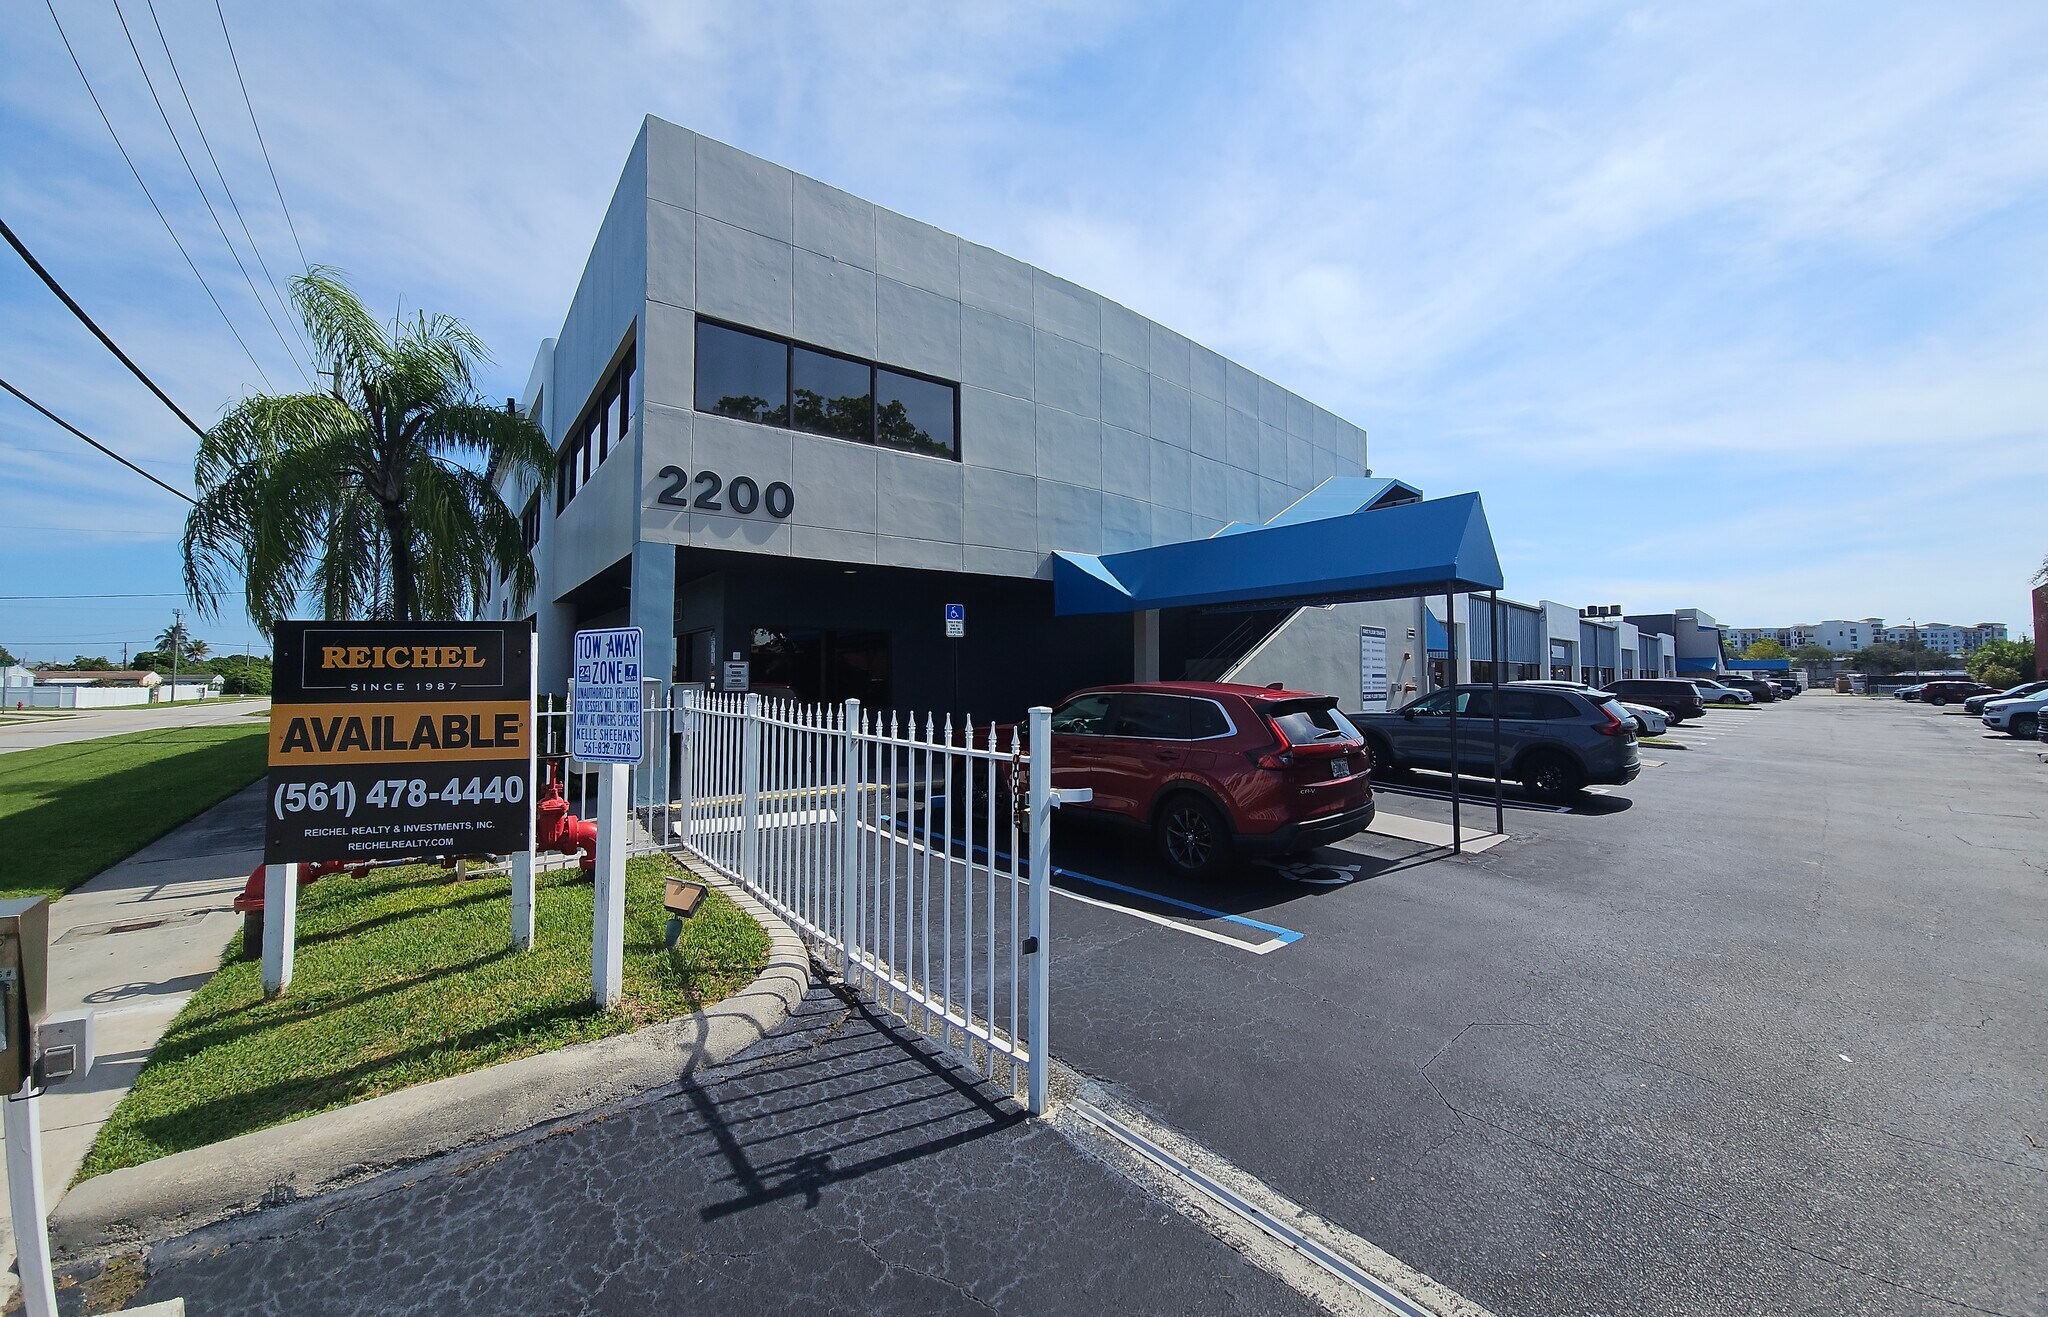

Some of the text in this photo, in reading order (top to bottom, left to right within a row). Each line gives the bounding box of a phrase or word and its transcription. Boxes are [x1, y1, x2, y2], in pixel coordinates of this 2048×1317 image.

[658, 465, 794, 518] 2200
[579, 634, 637, 659] TOW AWAY
[322, 646, 486, 669] REICHEL
[580, 666, 590, 677] 24
[592, 661, 623, 684] ZONE
[628, 665, 634, 676] 7
[351, 682, 457, 691] SINCE 1987
[577, 687, 639, 699] UNAUTHORIZED VEHICLES
[577, 701, 639, 713] OR VESSELS WILL BE TOWED
[577, 714, 588, 725] AWAY
[590, 714, 596, 726] AT
[618, 714, 639, 727] EXPENSE
[280, 713, 520, 753] AVAILABLE
[576, 728, 639, 742] KELLE SHEEHAN'S
[584, 741, 631, 755] 561-832-7878
[273, 775, 524, 820] (561) 478-4440
[304, 820, 495, 838] REICHEL REALTY & INVESTMENTS, INC.
[348, 838, 454, 851] REICHELREALTY.COM
